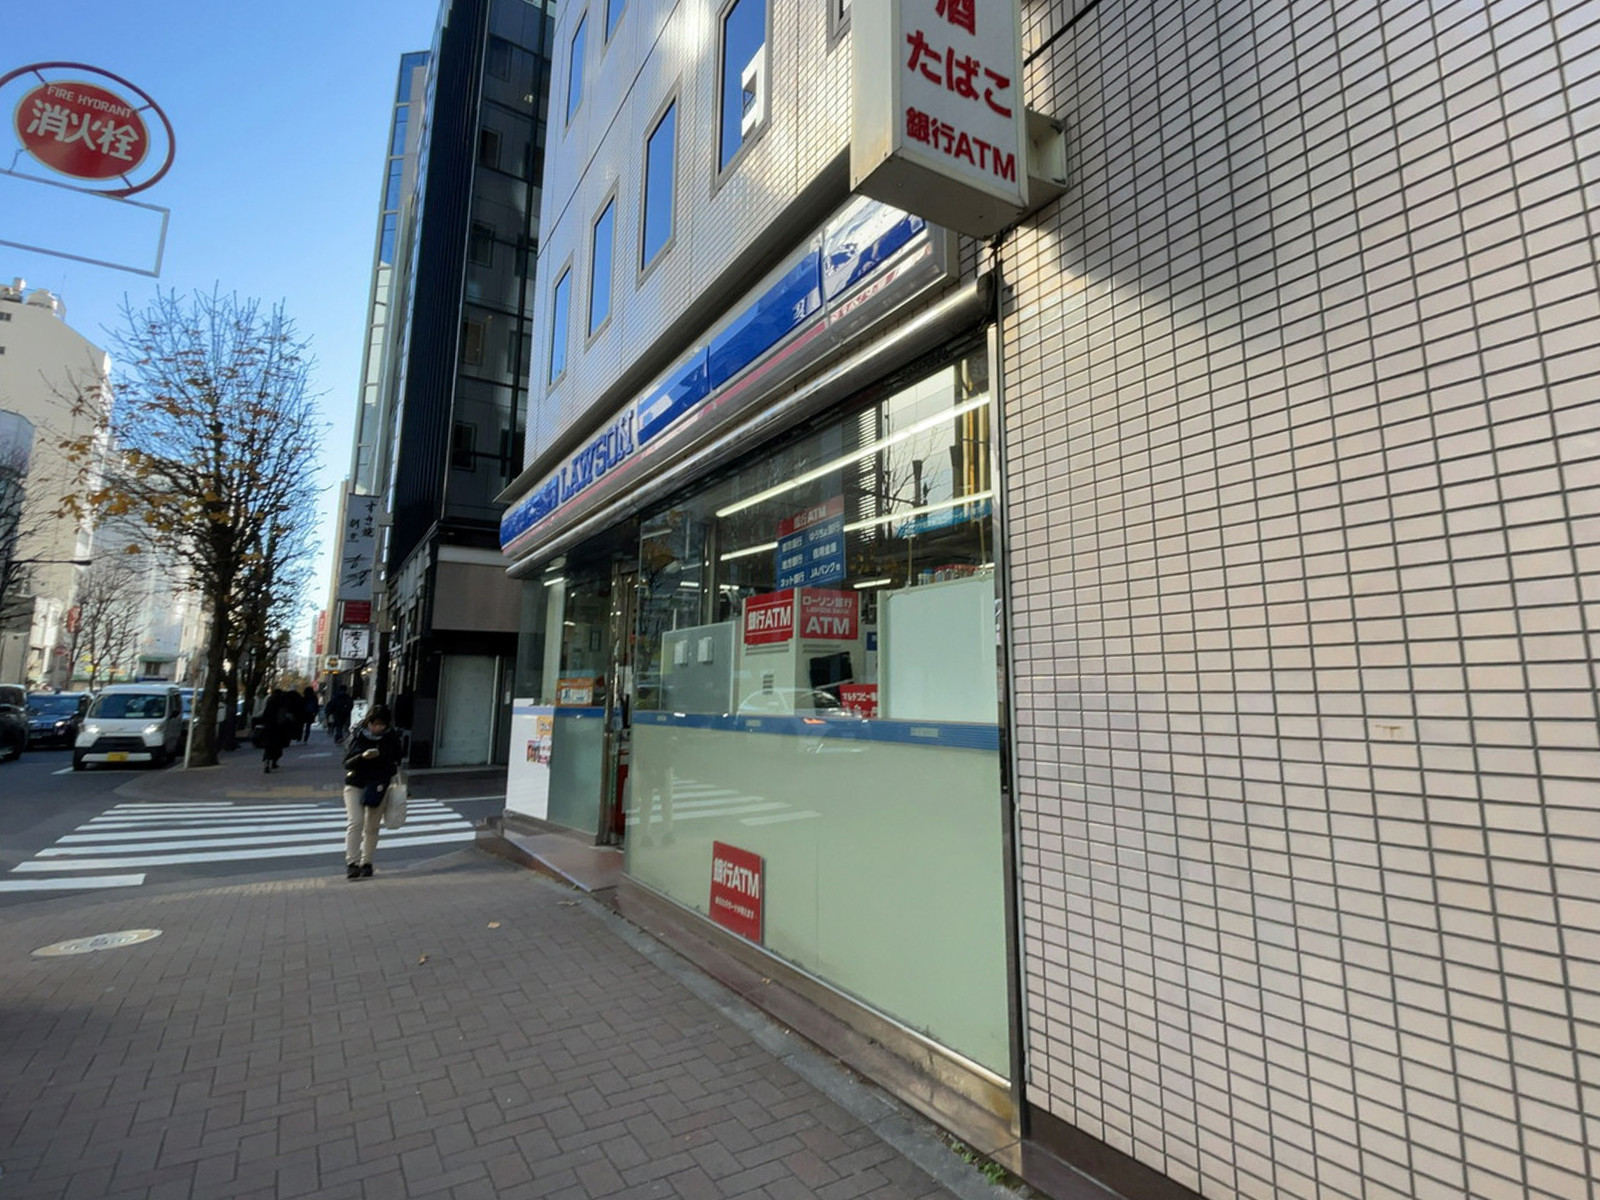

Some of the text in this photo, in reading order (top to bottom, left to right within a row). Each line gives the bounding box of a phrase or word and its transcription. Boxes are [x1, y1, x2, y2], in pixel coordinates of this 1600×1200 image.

[907, 30, 1012, 119] たばこ
[47, 86, 134, 118] FIRE HYDRANT
[27, 99, 139, 162] 消火栓
[906, 106, 1016, 184] 銀行ATM
[560, 409, 635, 504] LAWSON
[747, 605, 791, 631] 銀行ATM
[802, 596, 853, 608] ローソン銀行
[806, 616, 850, 635] ATM
[713, 858, 759, 899] 銀行ATM
